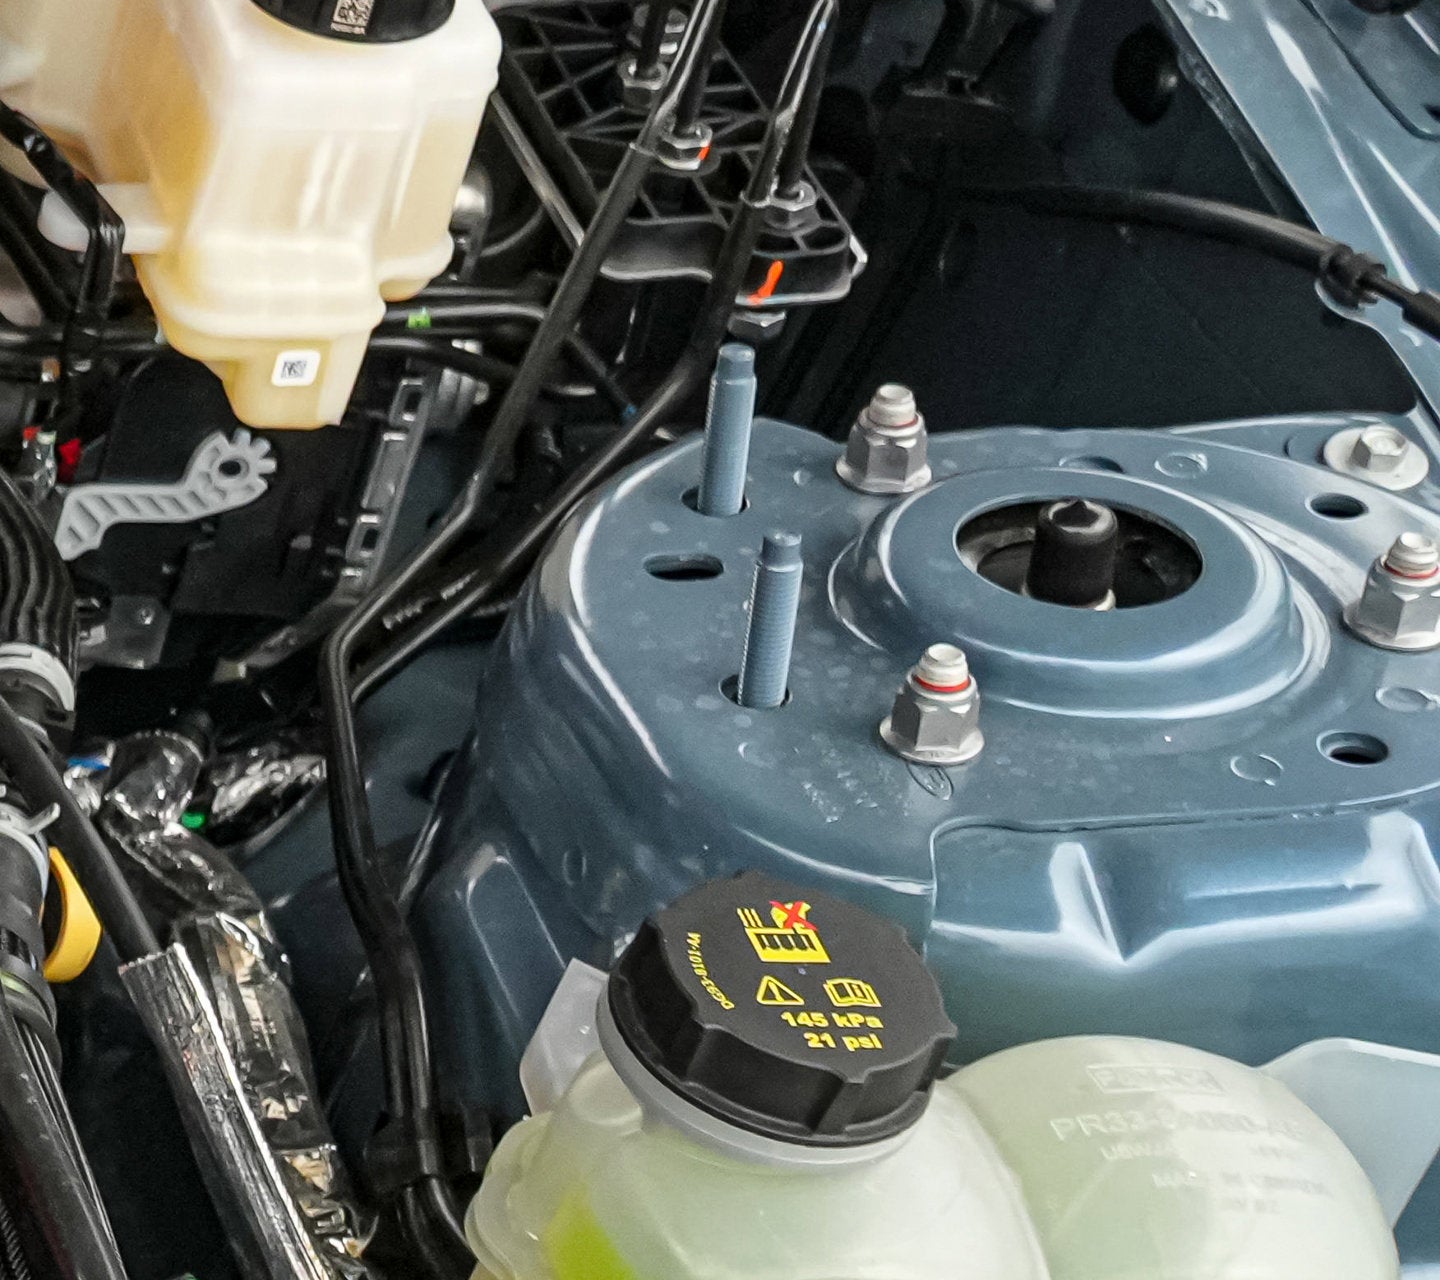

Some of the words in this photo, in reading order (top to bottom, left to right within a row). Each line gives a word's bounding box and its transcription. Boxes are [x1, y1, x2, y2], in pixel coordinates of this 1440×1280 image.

[781, 1011, 829, 1029] 145
[833, 1011, 885, 1030] kPa
[804, 1033, 836, 1049] 21
[842, 1033, 884, 1052] psi
